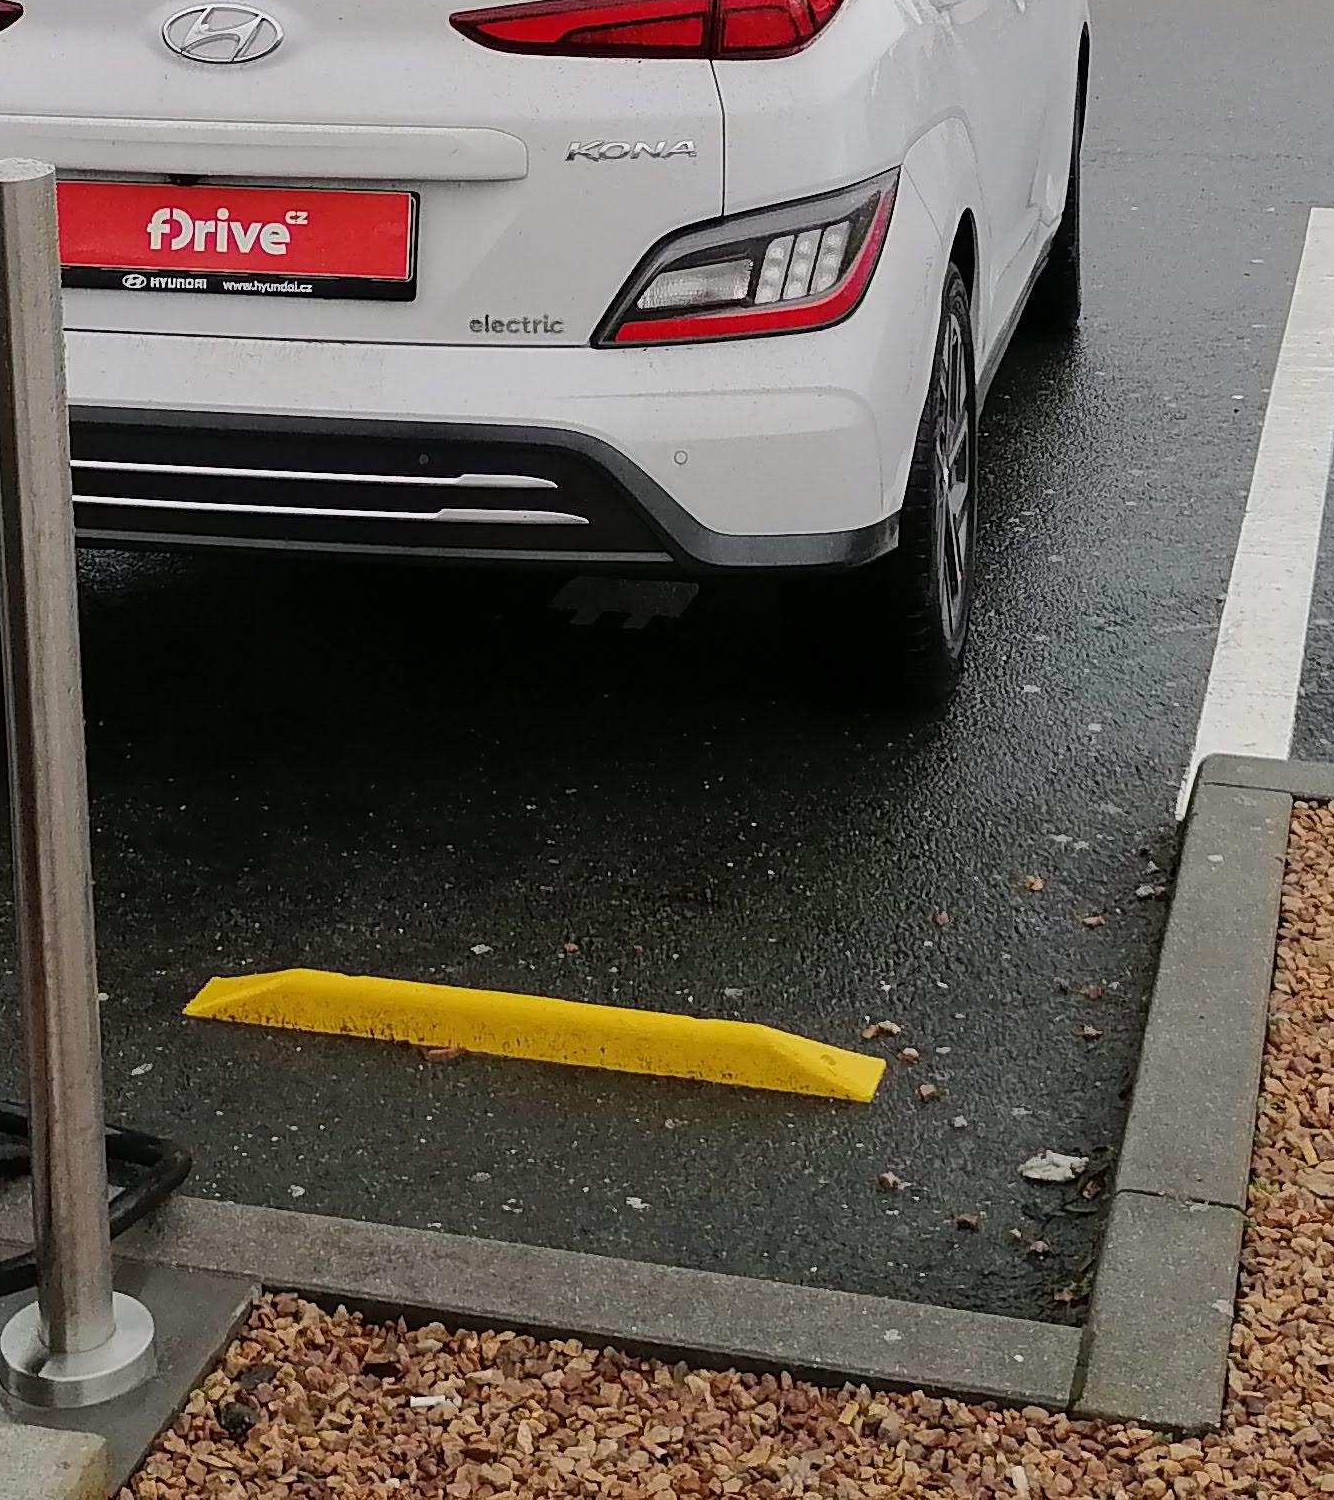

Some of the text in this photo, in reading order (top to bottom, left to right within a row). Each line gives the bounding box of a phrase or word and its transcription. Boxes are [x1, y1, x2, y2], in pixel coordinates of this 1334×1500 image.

[565, 140, 697, 162] KONA
[150, 276, 313, 293] HYUNDAI www.hyundai.cz
[469, 313, 564, 334] electric
